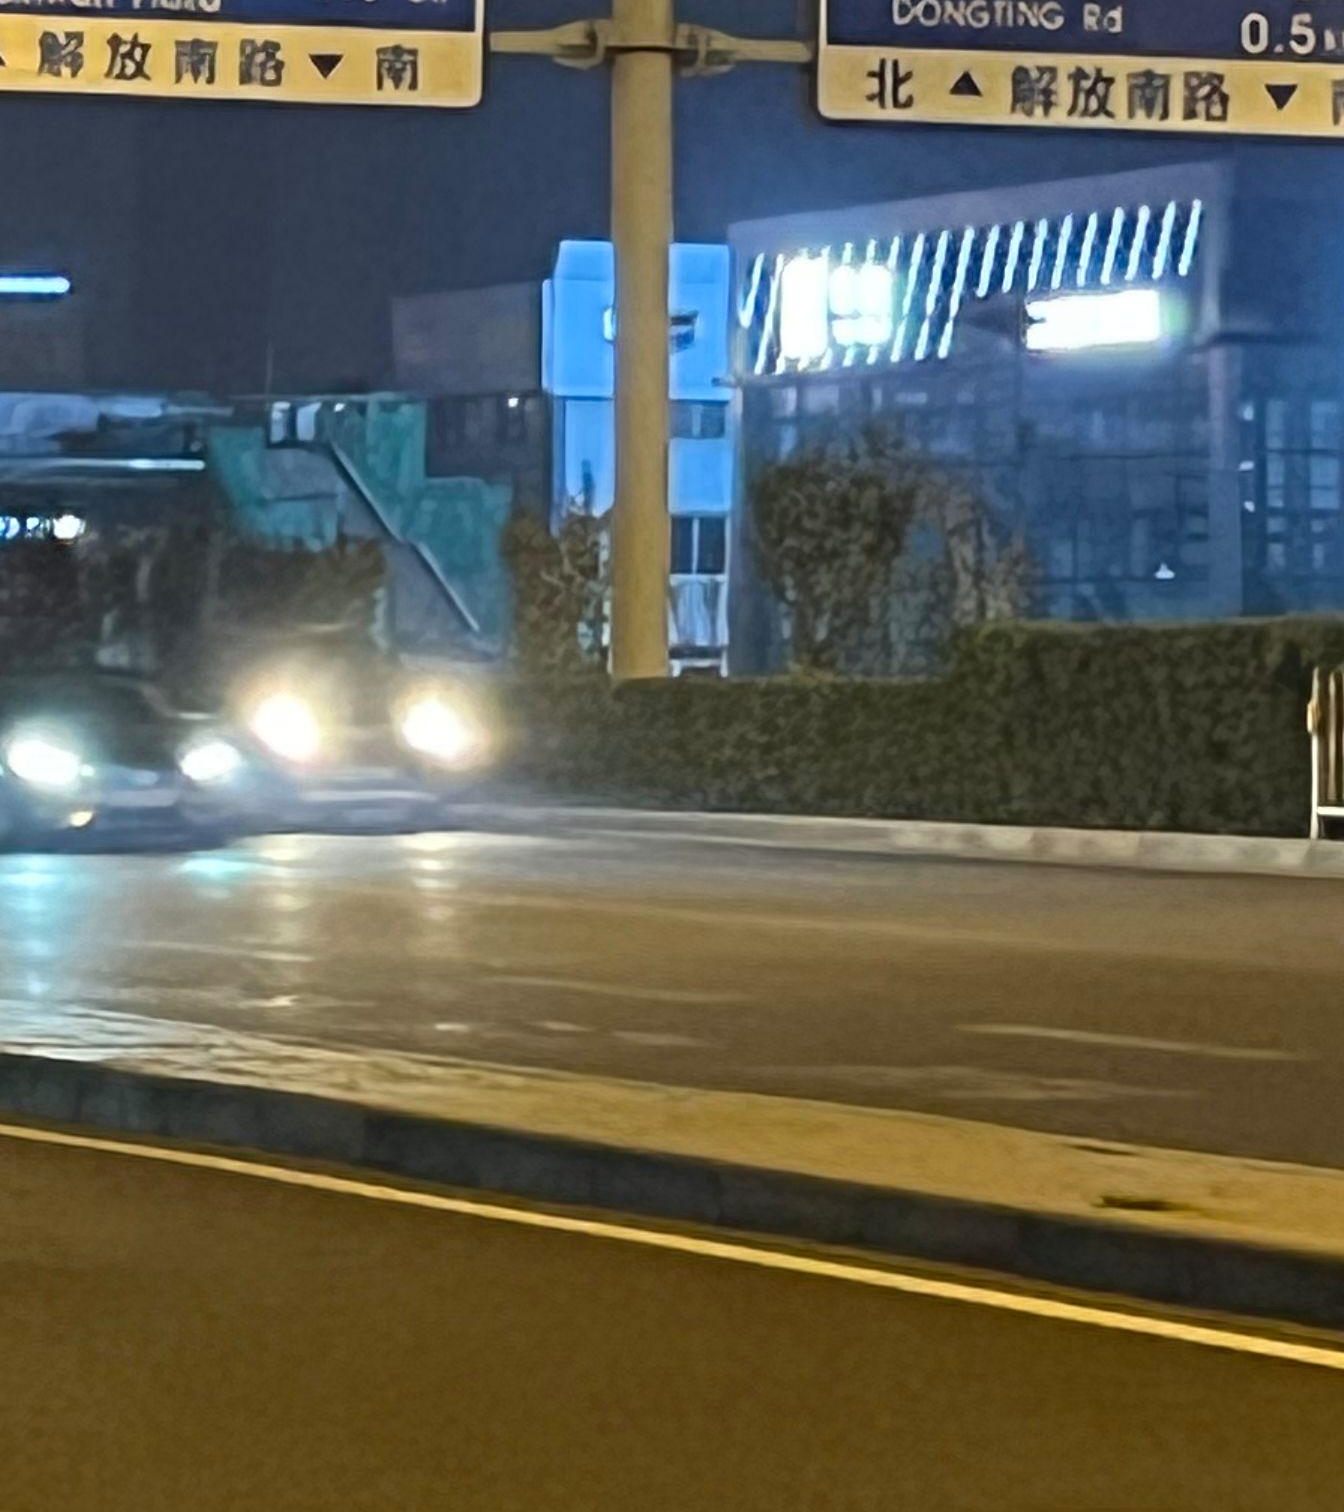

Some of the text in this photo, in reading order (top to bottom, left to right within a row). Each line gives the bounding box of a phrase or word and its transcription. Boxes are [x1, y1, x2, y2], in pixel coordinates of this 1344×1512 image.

[1082, 2, 1124, 34] Rd
[1240, 12, 1317, 55] 0.5
[37, 29, 286, 88] 解放南路
[375, 43, 419, 91] 南
[865, 56, 916, 110] 北
[1009, 63, 1230, 122] 解放南路
